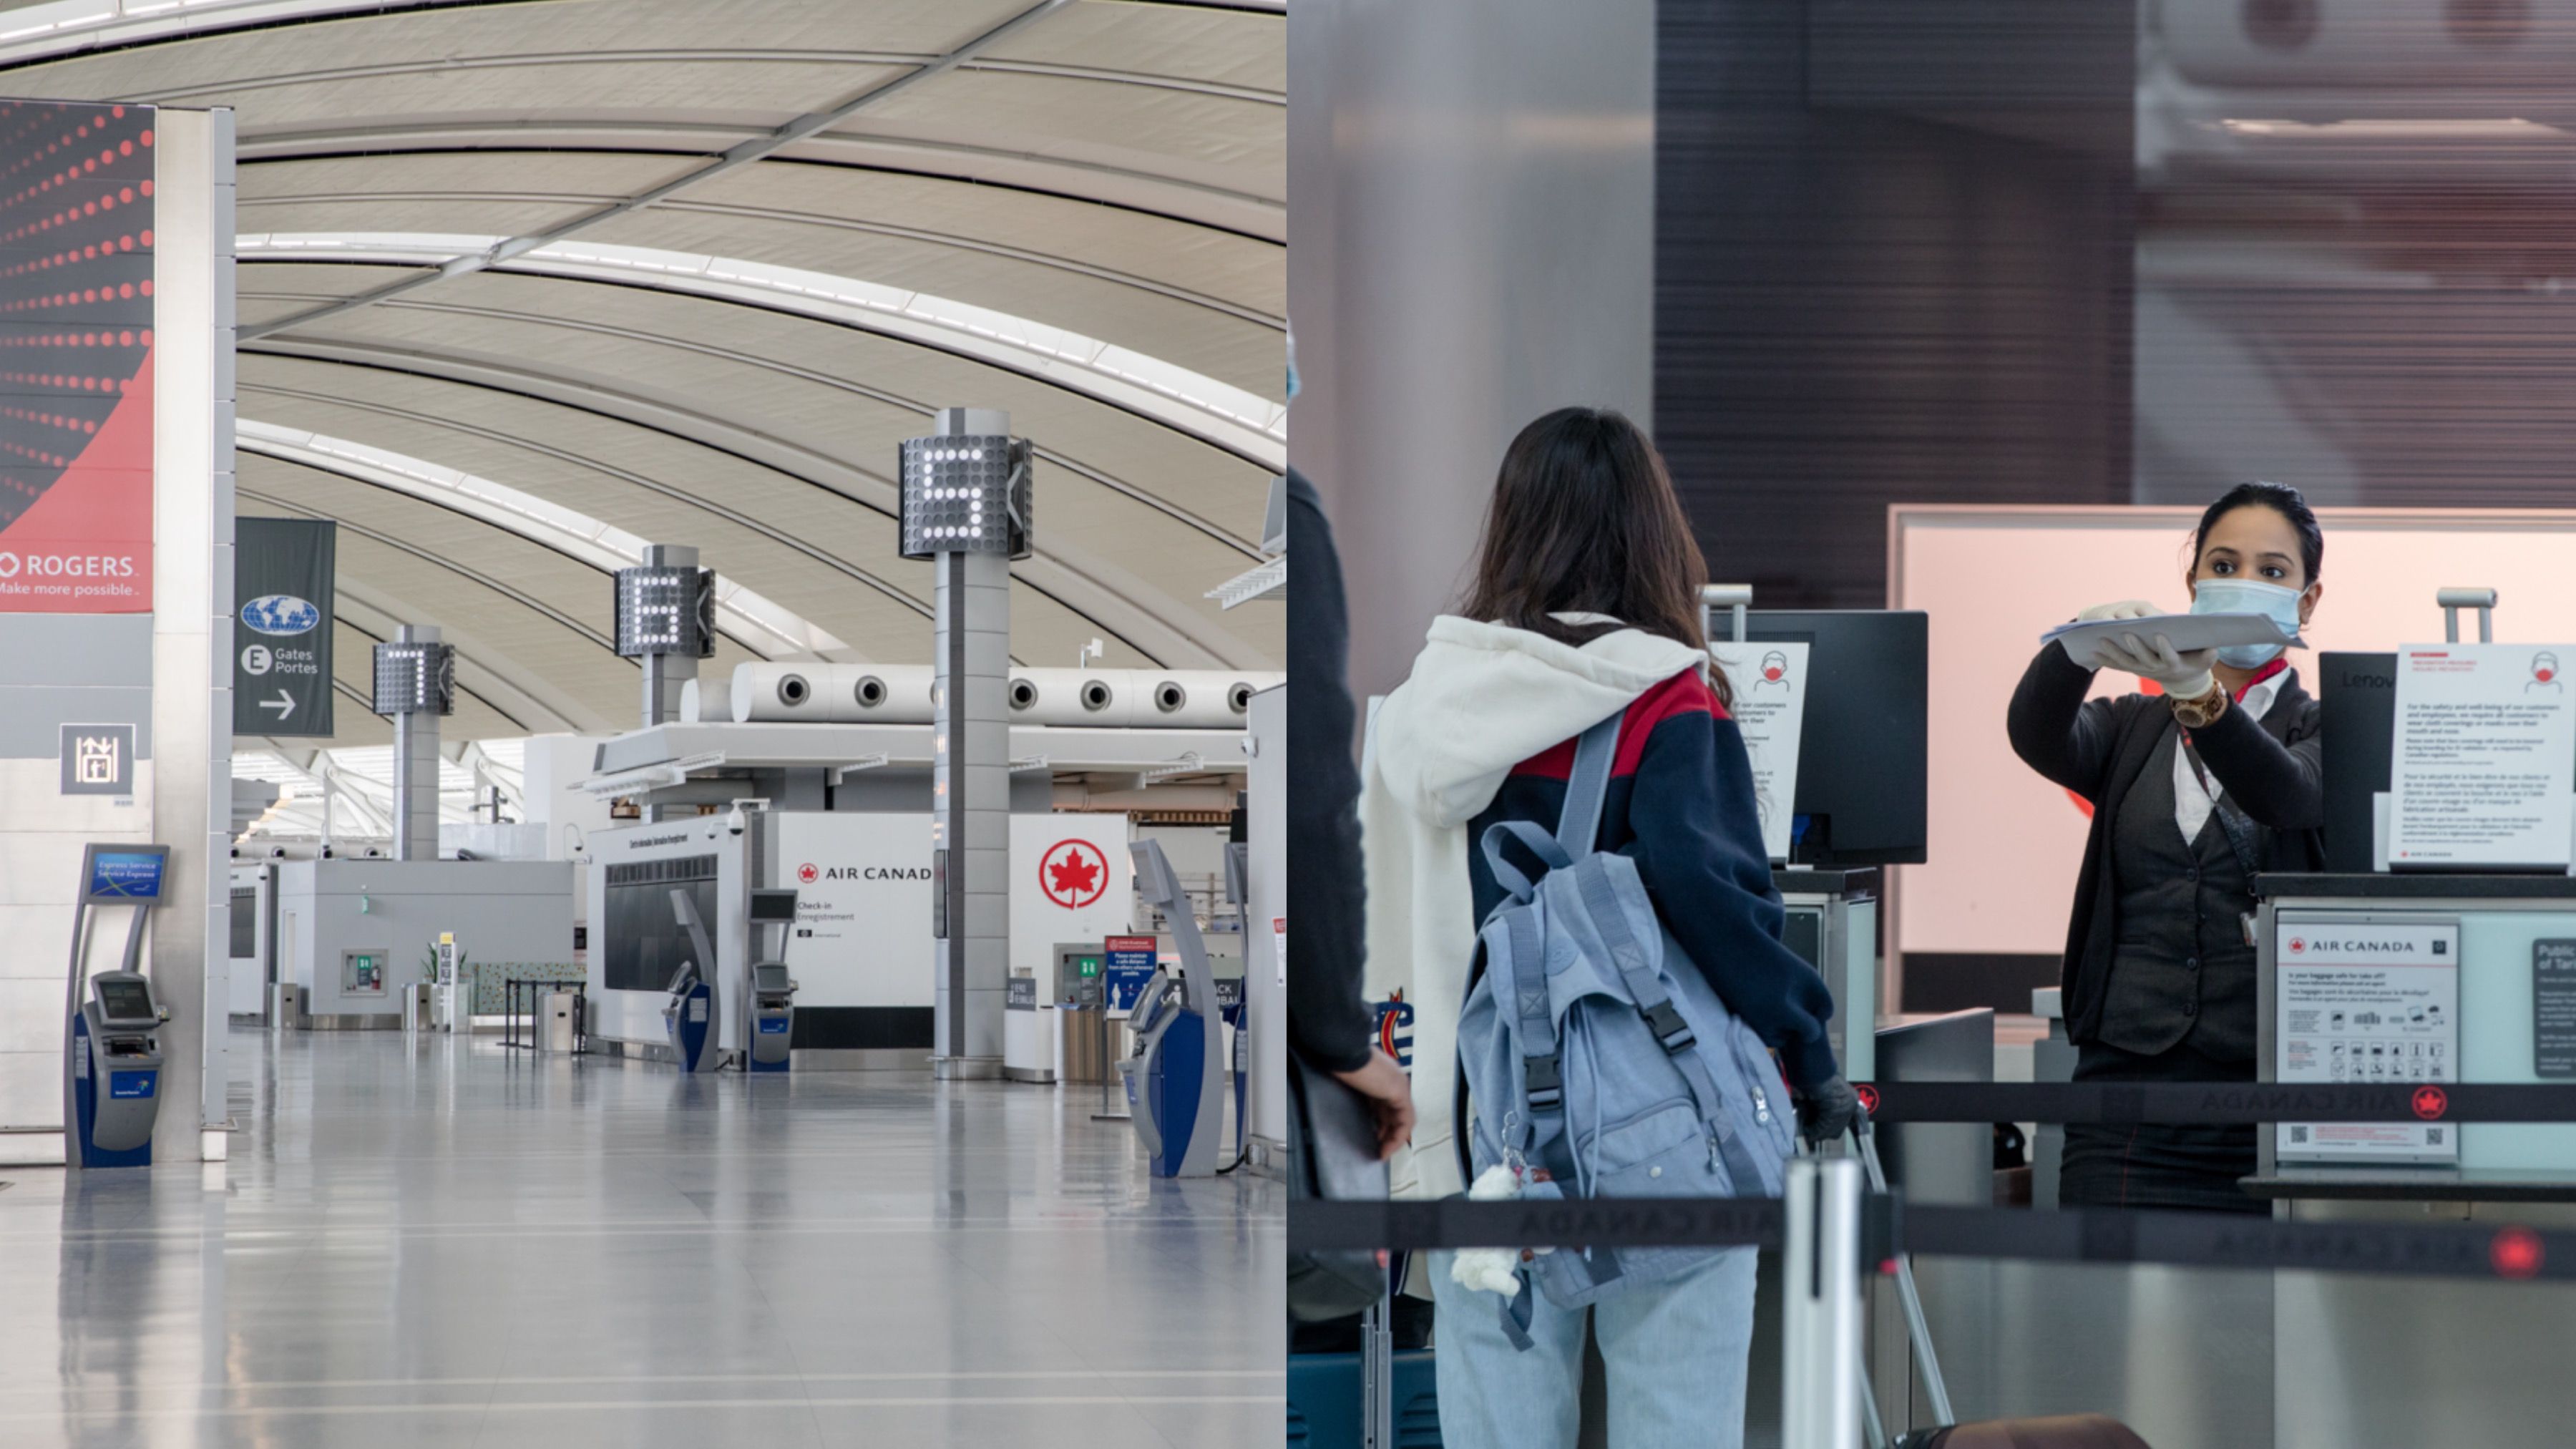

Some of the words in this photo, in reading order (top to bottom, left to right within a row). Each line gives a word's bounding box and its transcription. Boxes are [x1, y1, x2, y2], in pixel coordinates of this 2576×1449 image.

[924, 449, 982, 538] 5
[27, 555, 134, 577] ROGERS
[35, 585, 70, 595] more
[634, 576, 679, 644] 6
[250, 649, 263, 670] E
[275, 648, 313, 660] Gates
[275, 660, 318, 674] Portes
[2343, 671, 2395, 688] Lenov
[99, 862, 127, 870] Express
[826, 867, 859, 879] AIR
[864, 867, 932, 880] CANAD
[796, 913, 854, 922] Enregistrement
[2312, 941, 2339, 951] AIR
[2344, 941, 2414, 952] CANADA
[2538, 945, 2575, 957] Public
